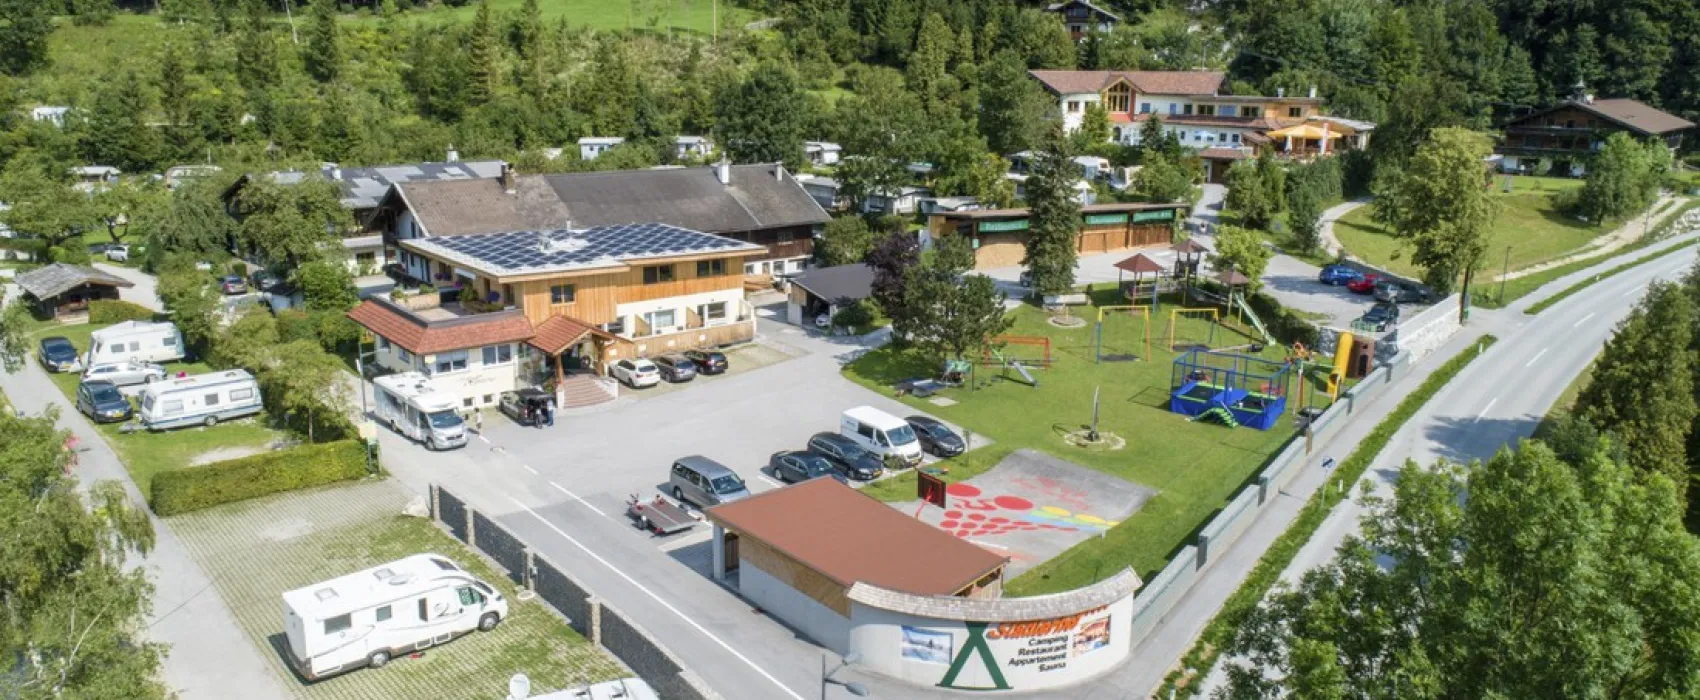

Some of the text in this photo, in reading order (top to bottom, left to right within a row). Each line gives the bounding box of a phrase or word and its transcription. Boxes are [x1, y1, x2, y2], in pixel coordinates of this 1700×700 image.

[1028, 635, 1068, 647] Camping
[1018, 643, 1067, 656] Restaurant
[1008, 652, 1066, 667] Appartement
[1038, 661, 1066, 673] Sauna
